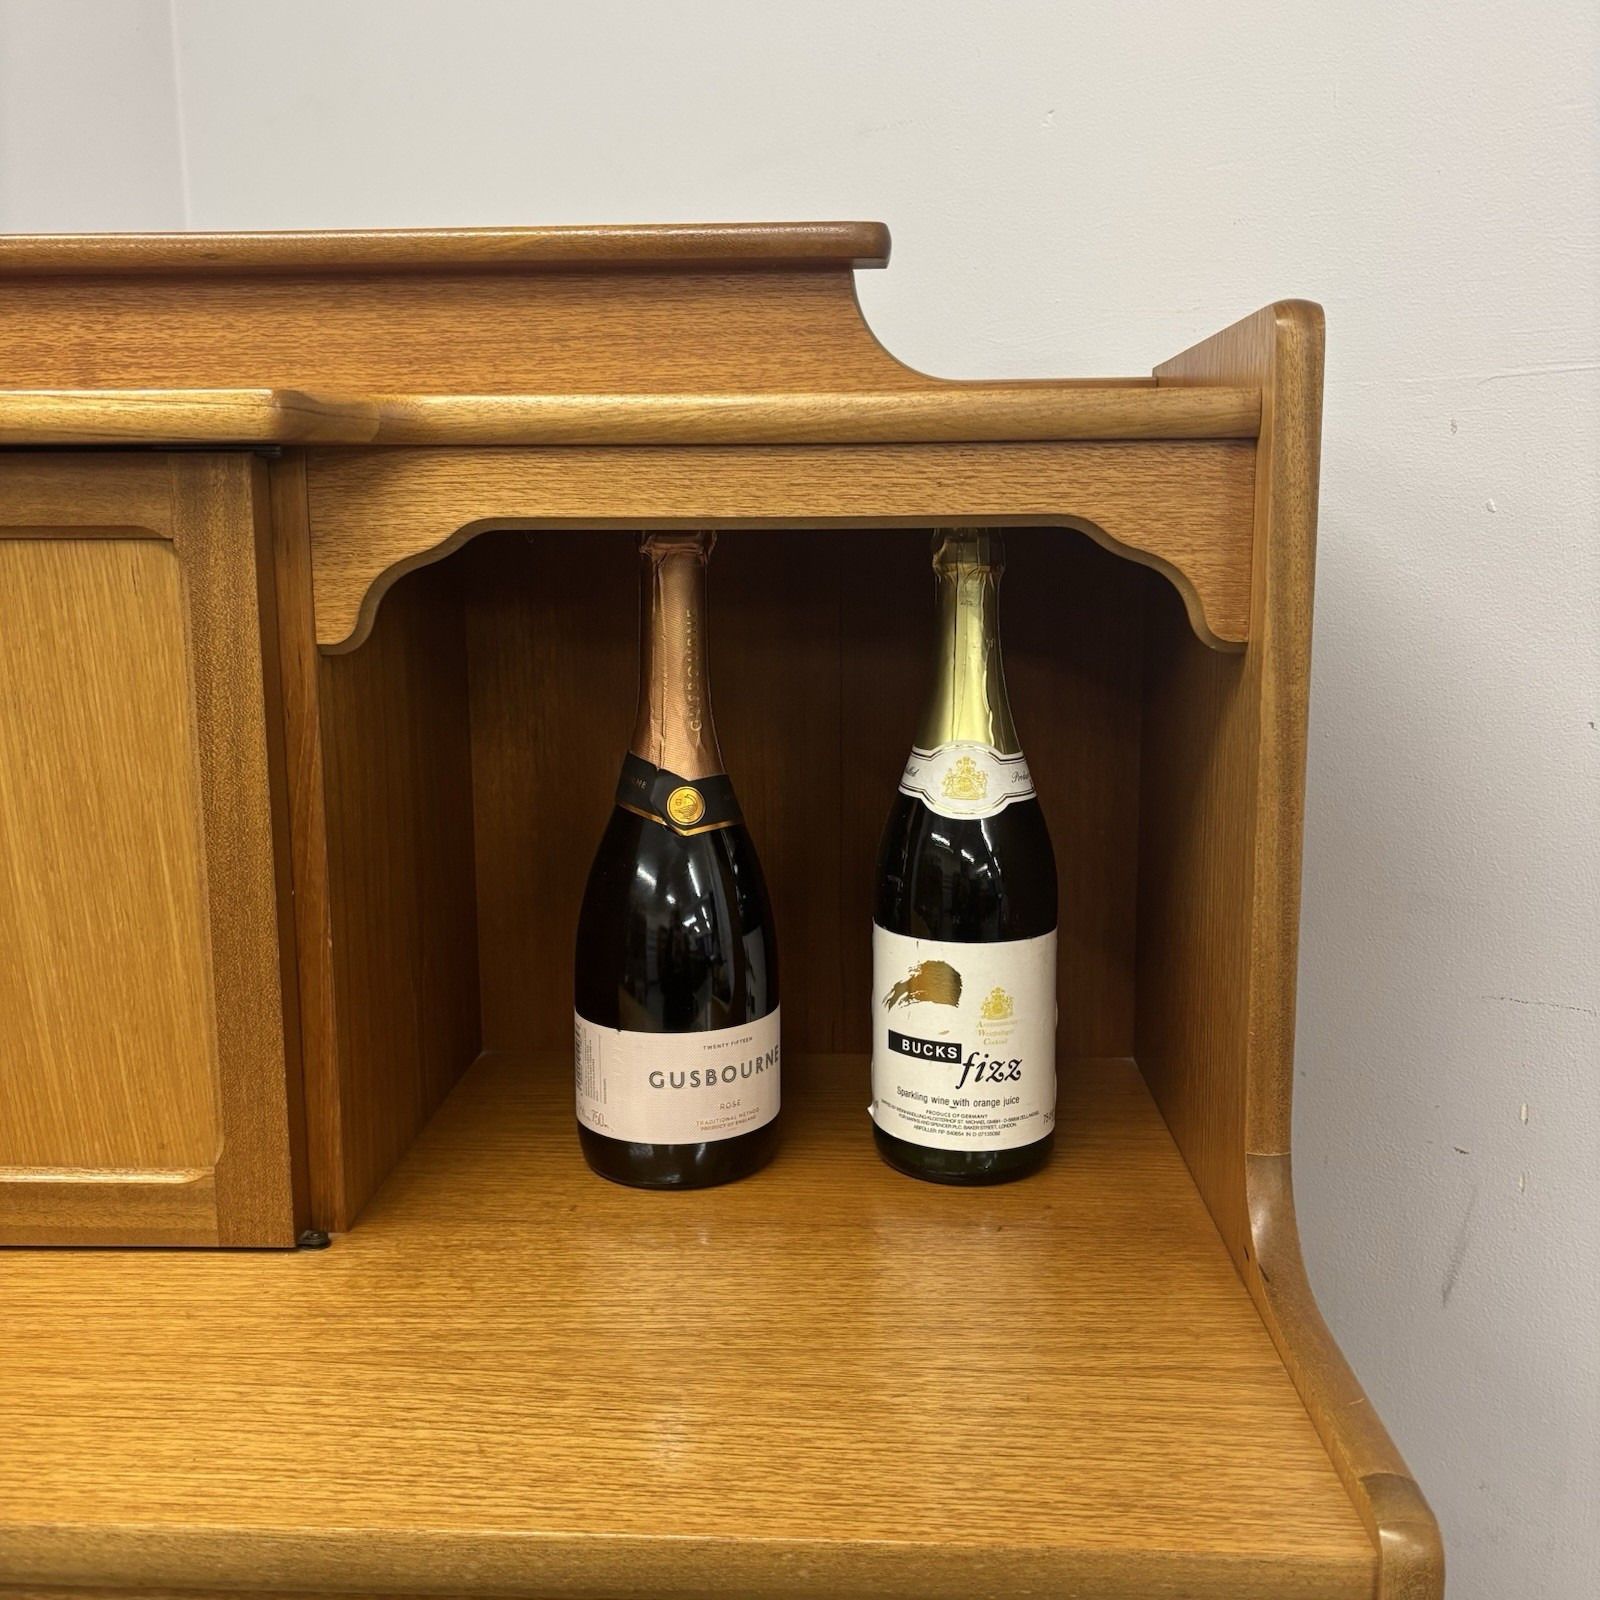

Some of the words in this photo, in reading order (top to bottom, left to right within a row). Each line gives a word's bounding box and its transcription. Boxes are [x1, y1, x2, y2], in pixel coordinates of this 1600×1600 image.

[703, 1042, 729, 1051] TWENTY
[730, 1036, 753, 1046] FIFTEEN
[648, 1044, 779, 1089] GUSBOURNE
[901, 1038, 958, 1059] BUCKS
[955, 1051, 1023, 1090] fizz
[897, 1085, 928, 1104] Sparkling
[931, 1096, 950, 1106] wine
[953, 1097, 970, 1107] with
[973, 1099, 1001, 1109] orange
[1003, 1095, 1020, 1107] juice
[696, 1114, 737, 1127] TRADITIONAL
[926, 1109, 951, 1118] PRODUCE
